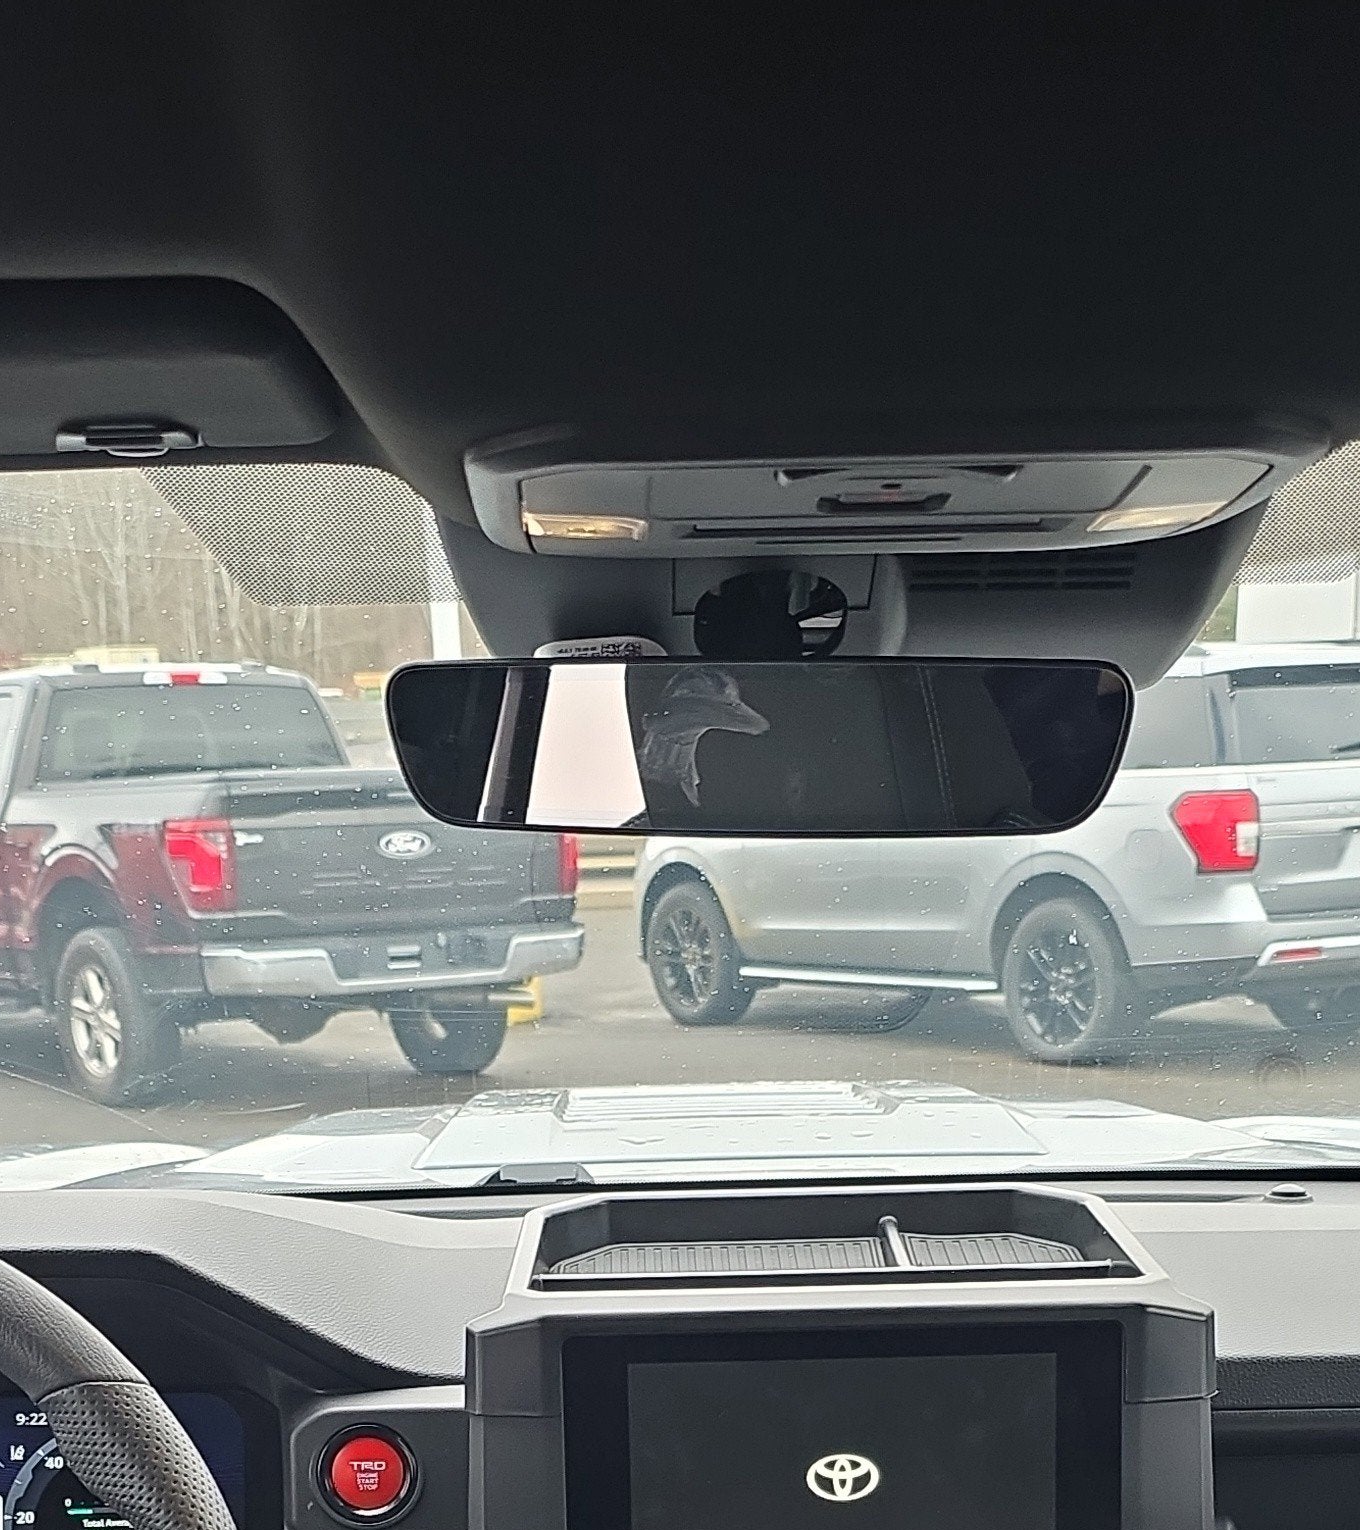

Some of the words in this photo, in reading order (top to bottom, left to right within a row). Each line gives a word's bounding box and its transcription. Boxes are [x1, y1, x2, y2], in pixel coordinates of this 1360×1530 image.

[15, 1413, 49, 1426] 9:22
[44, 1456, 64, 1469] 40
[349, 1461, 387, 1471] TRD
[16, 1511, 35, 1524] 20
[82, 1518, 104, 1528] Total
